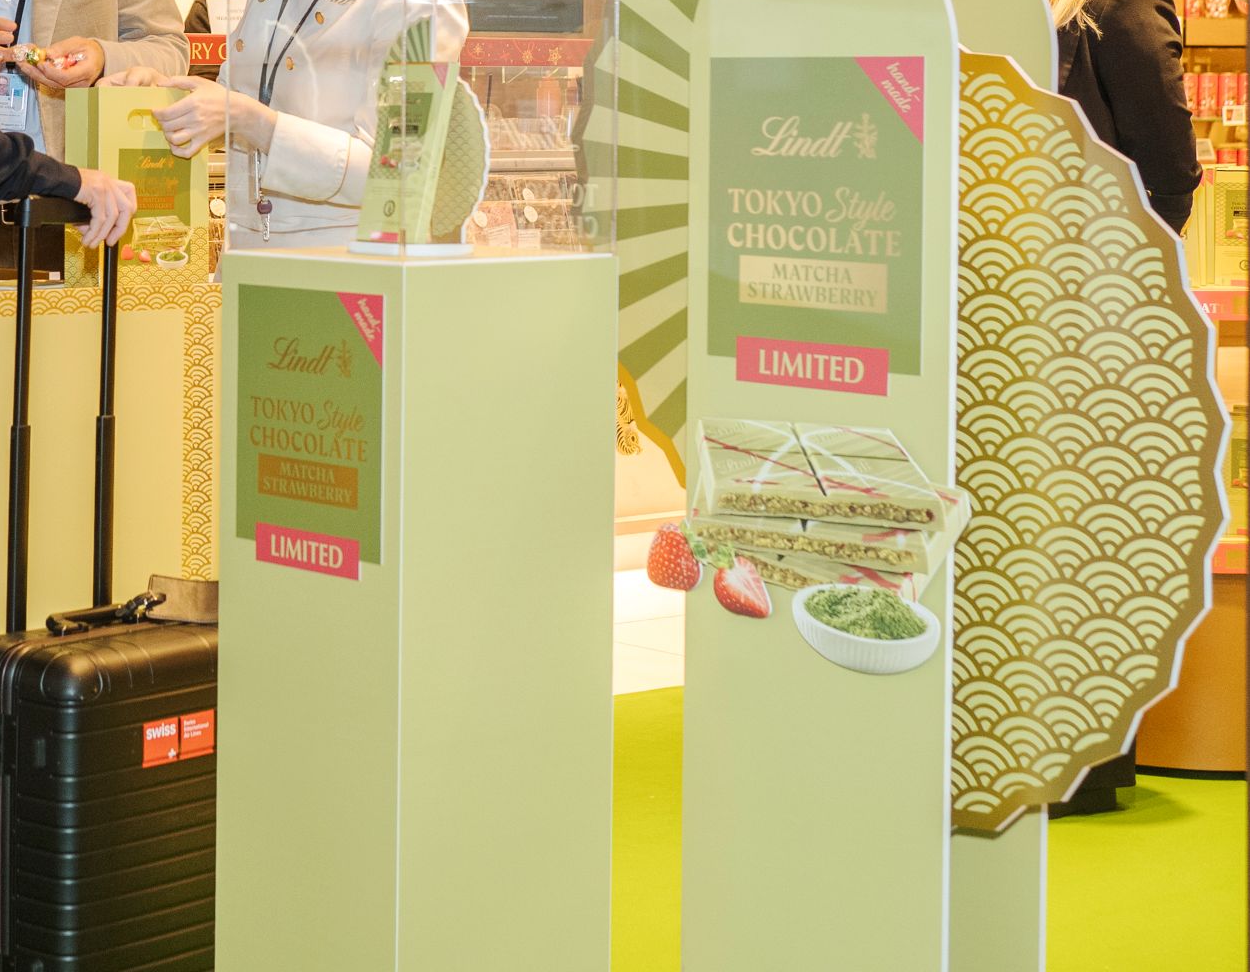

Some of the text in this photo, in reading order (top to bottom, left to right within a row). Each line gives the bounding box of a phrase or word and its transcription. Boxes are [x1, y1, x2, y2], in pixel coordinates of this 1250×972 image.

[750, 115, 854, 159] Lindt
[727, 186, 896, 229] TOKYO Style
[726, 222, 902, 257] CHOCOLATE
[771, 262, 854, 285] MATCHA
[746, 280, 878, 309] STRAWBERRY
[267, 336, 335, 376] Lindt
[758, 348, 865, 384] LIMITED
[251, 395, 365, 435] TOKYO Style
[250, 425, 367, 462] CHOCOLATE
[263, 475, 351, 503] STRAWBERRY
[279, 461, 335, 485] MATCHA
[270, 533, 344, 569] LIMITED
[146, 722, 176, 740] swiss
